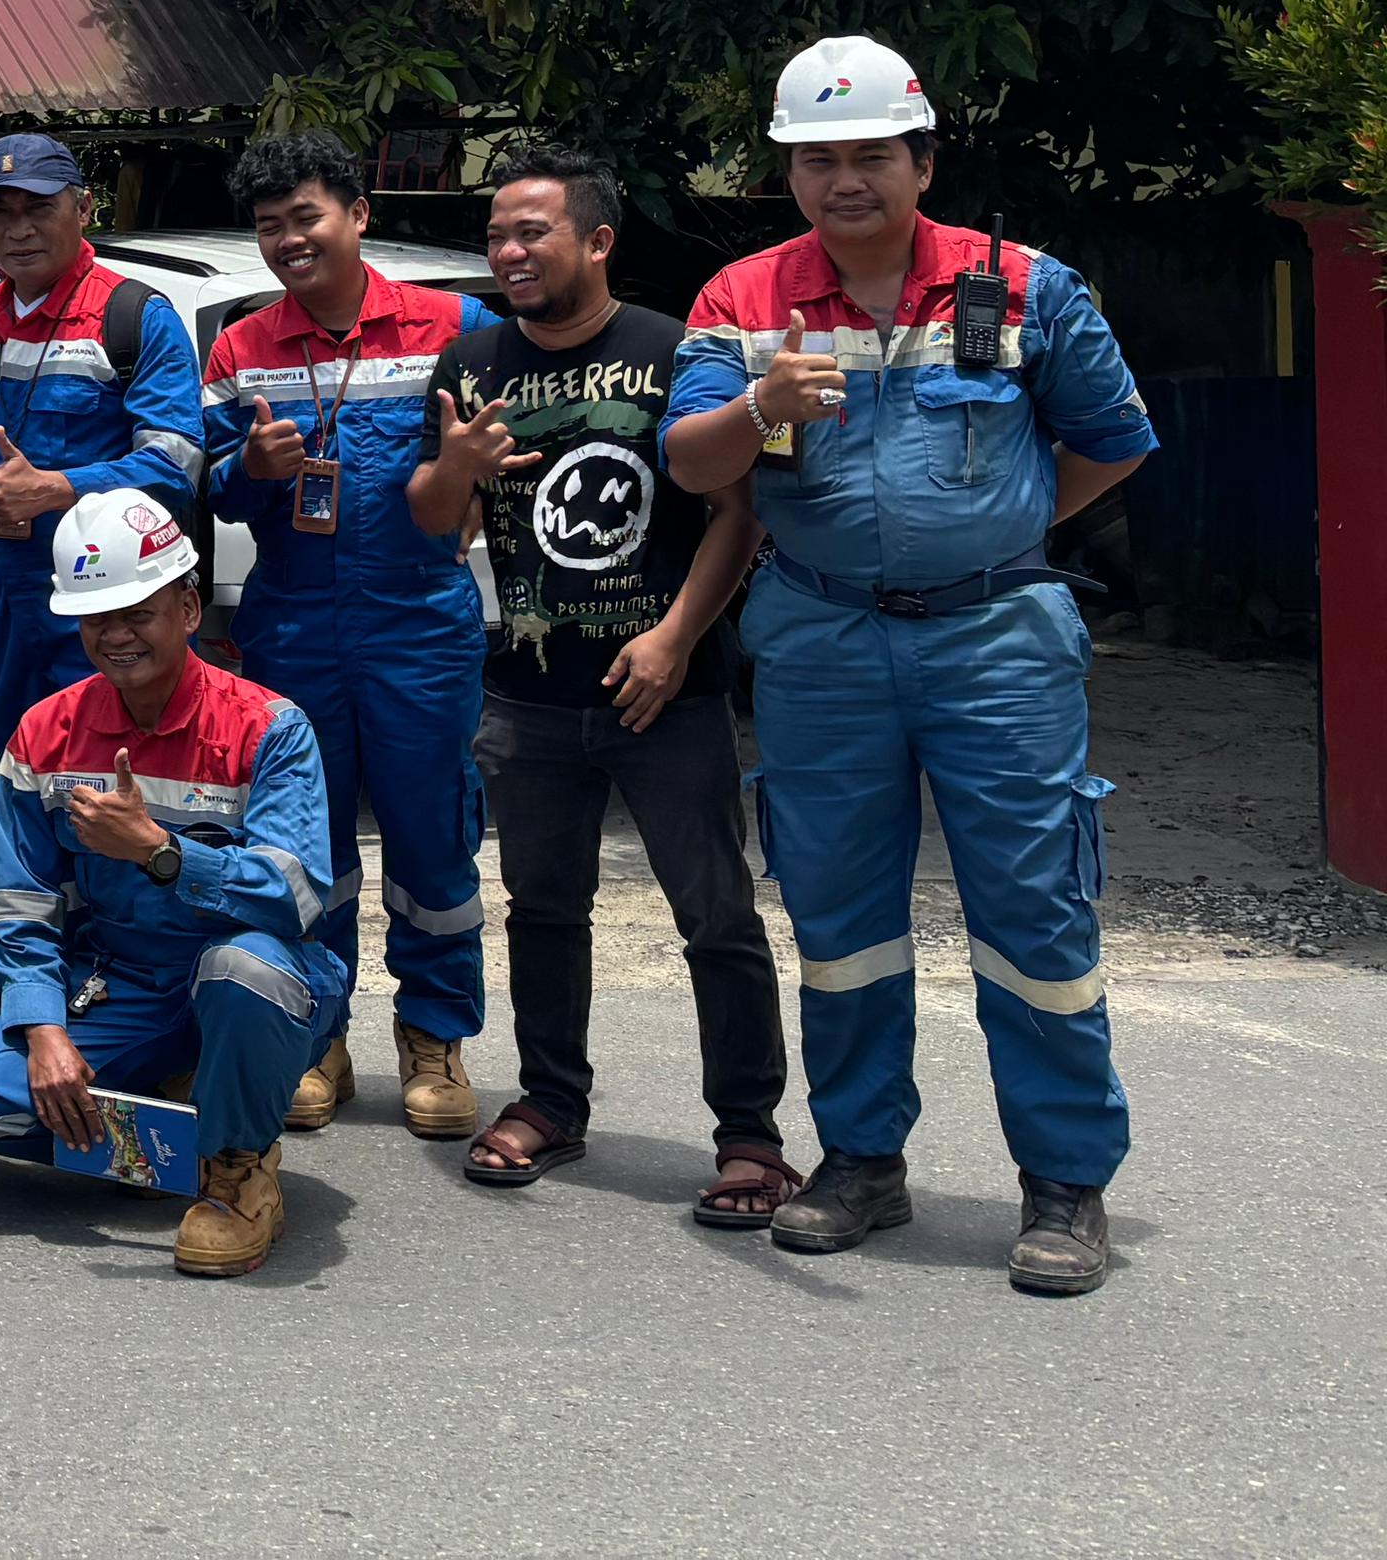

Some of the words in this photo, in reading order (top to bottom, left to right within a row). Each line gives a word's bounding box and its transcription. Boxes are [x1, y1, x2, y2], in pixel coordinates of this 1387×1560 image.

[499, 359, 665, 410] CHEERFUL
[593, 574, 644, 591] INFINITE
[558, 593, 656, 616] POSSIBILITIES
[579, 624, 606, 638] THE
[612, 618, 659, 637] FUTUR
